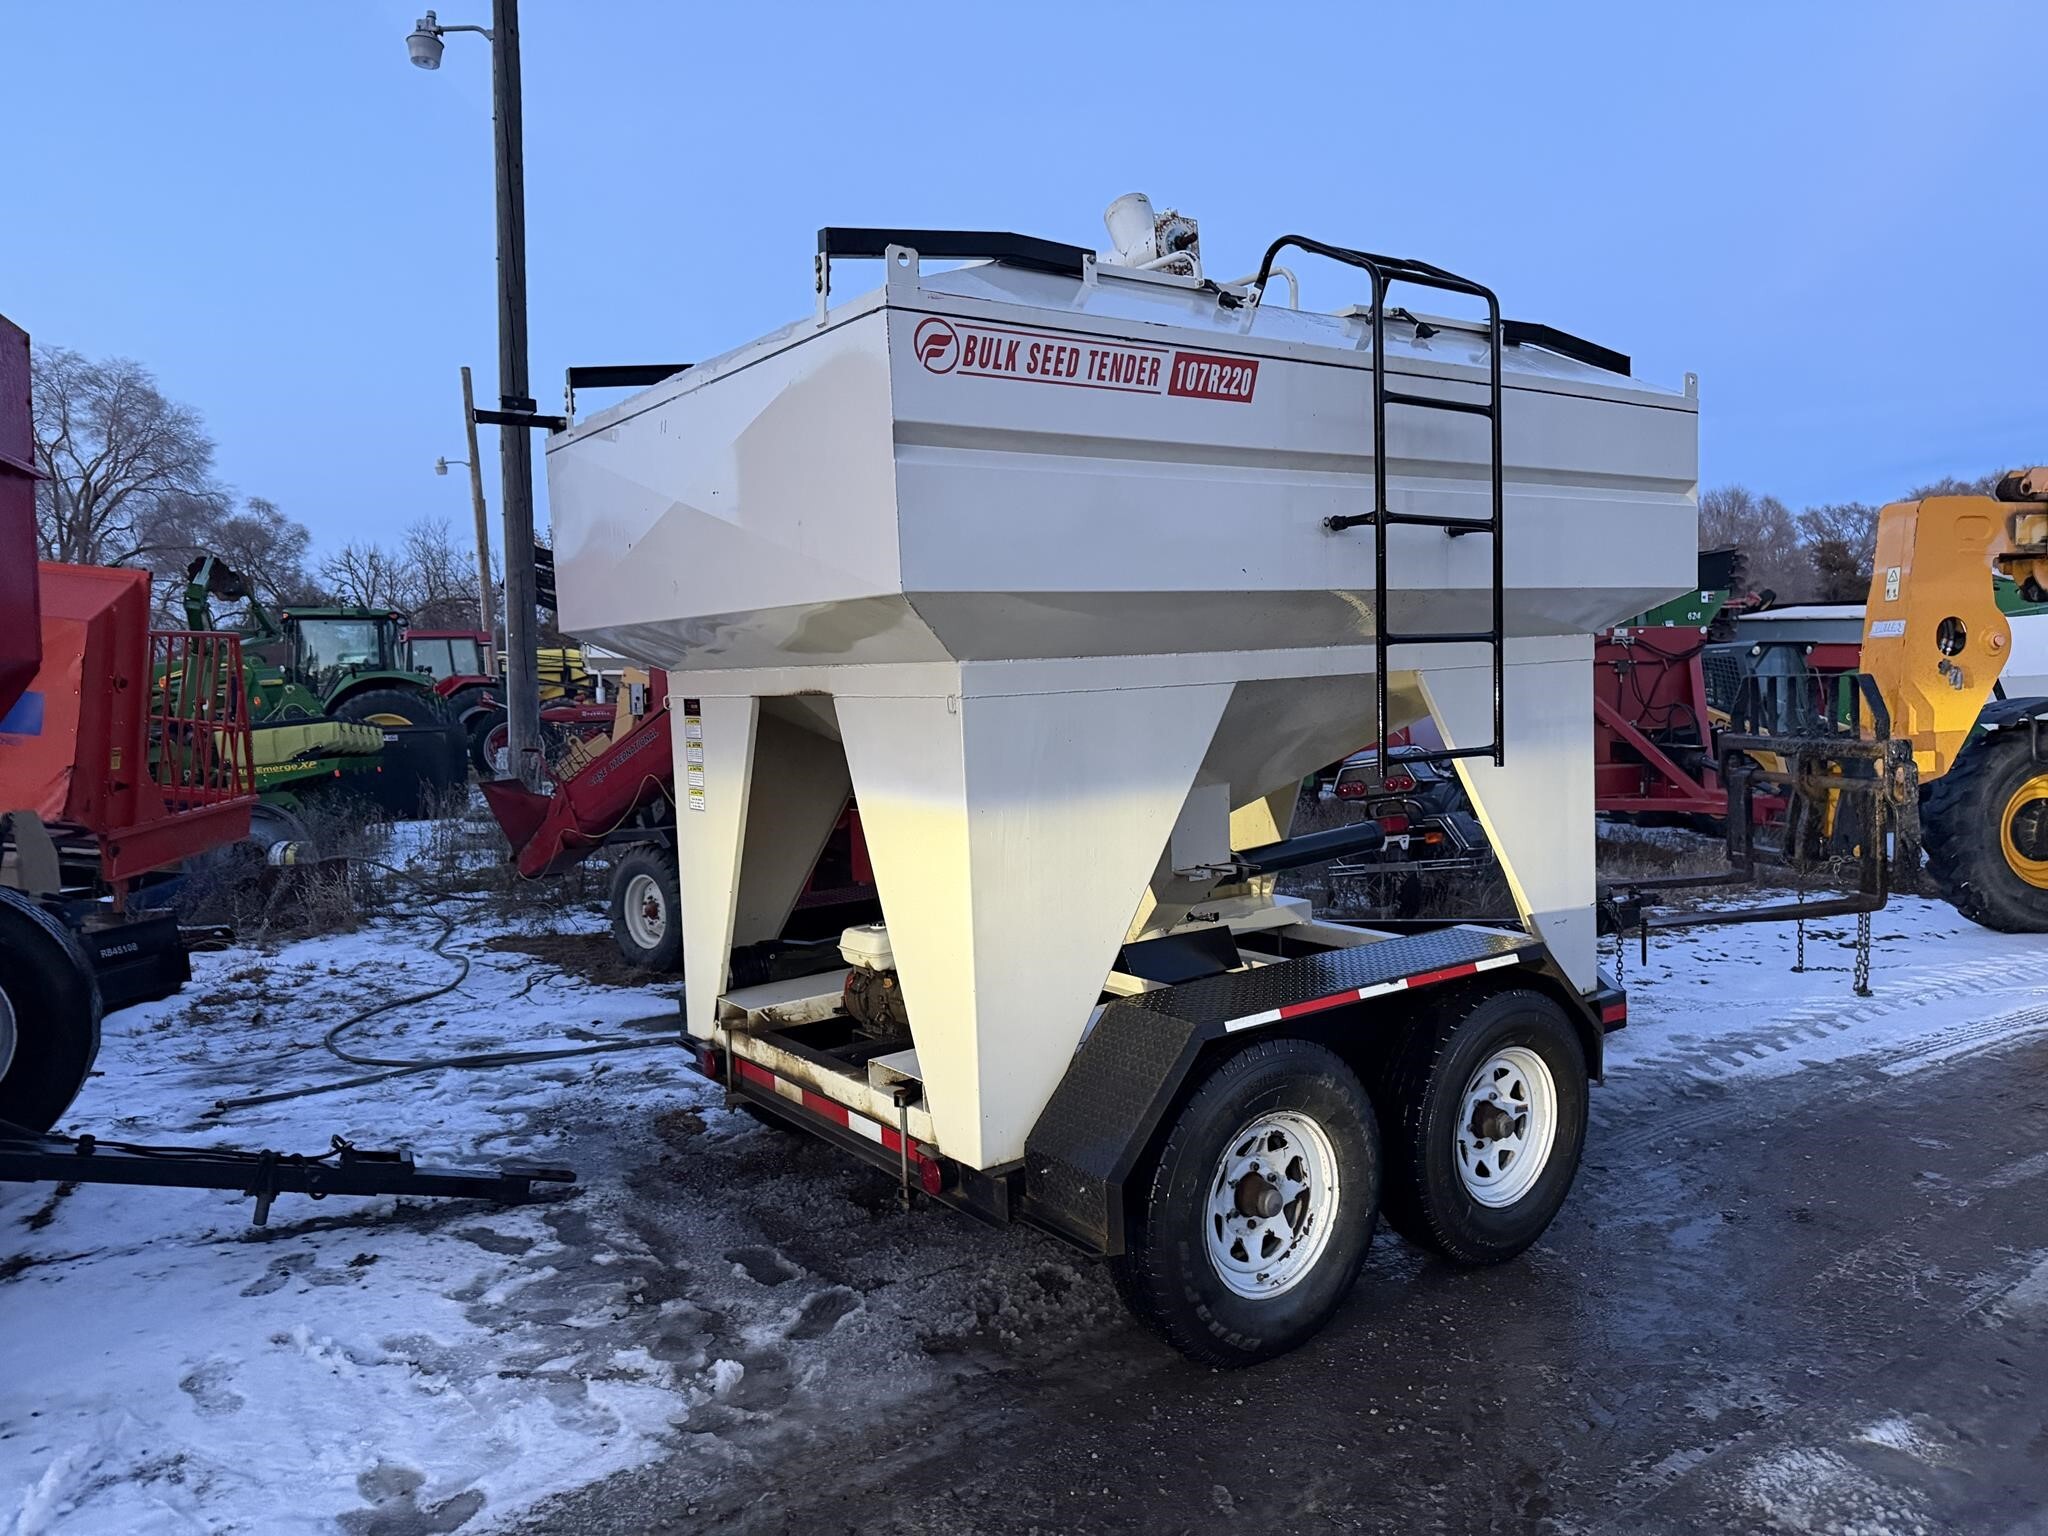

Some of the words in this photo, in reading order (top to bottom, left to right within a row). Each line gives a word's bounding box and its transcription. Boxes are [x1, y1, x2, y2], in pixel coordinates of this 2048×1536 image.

[962, 334, 1021, 373] BULK
[1026, 342, 1080, 378] SEED
[1087, 349, 1162, 387] TENDER
[1174, 360, 1254, 397] 107R220
[238, 763, 298, 776] aEmerge
[298, 760, 318, 771] XP
